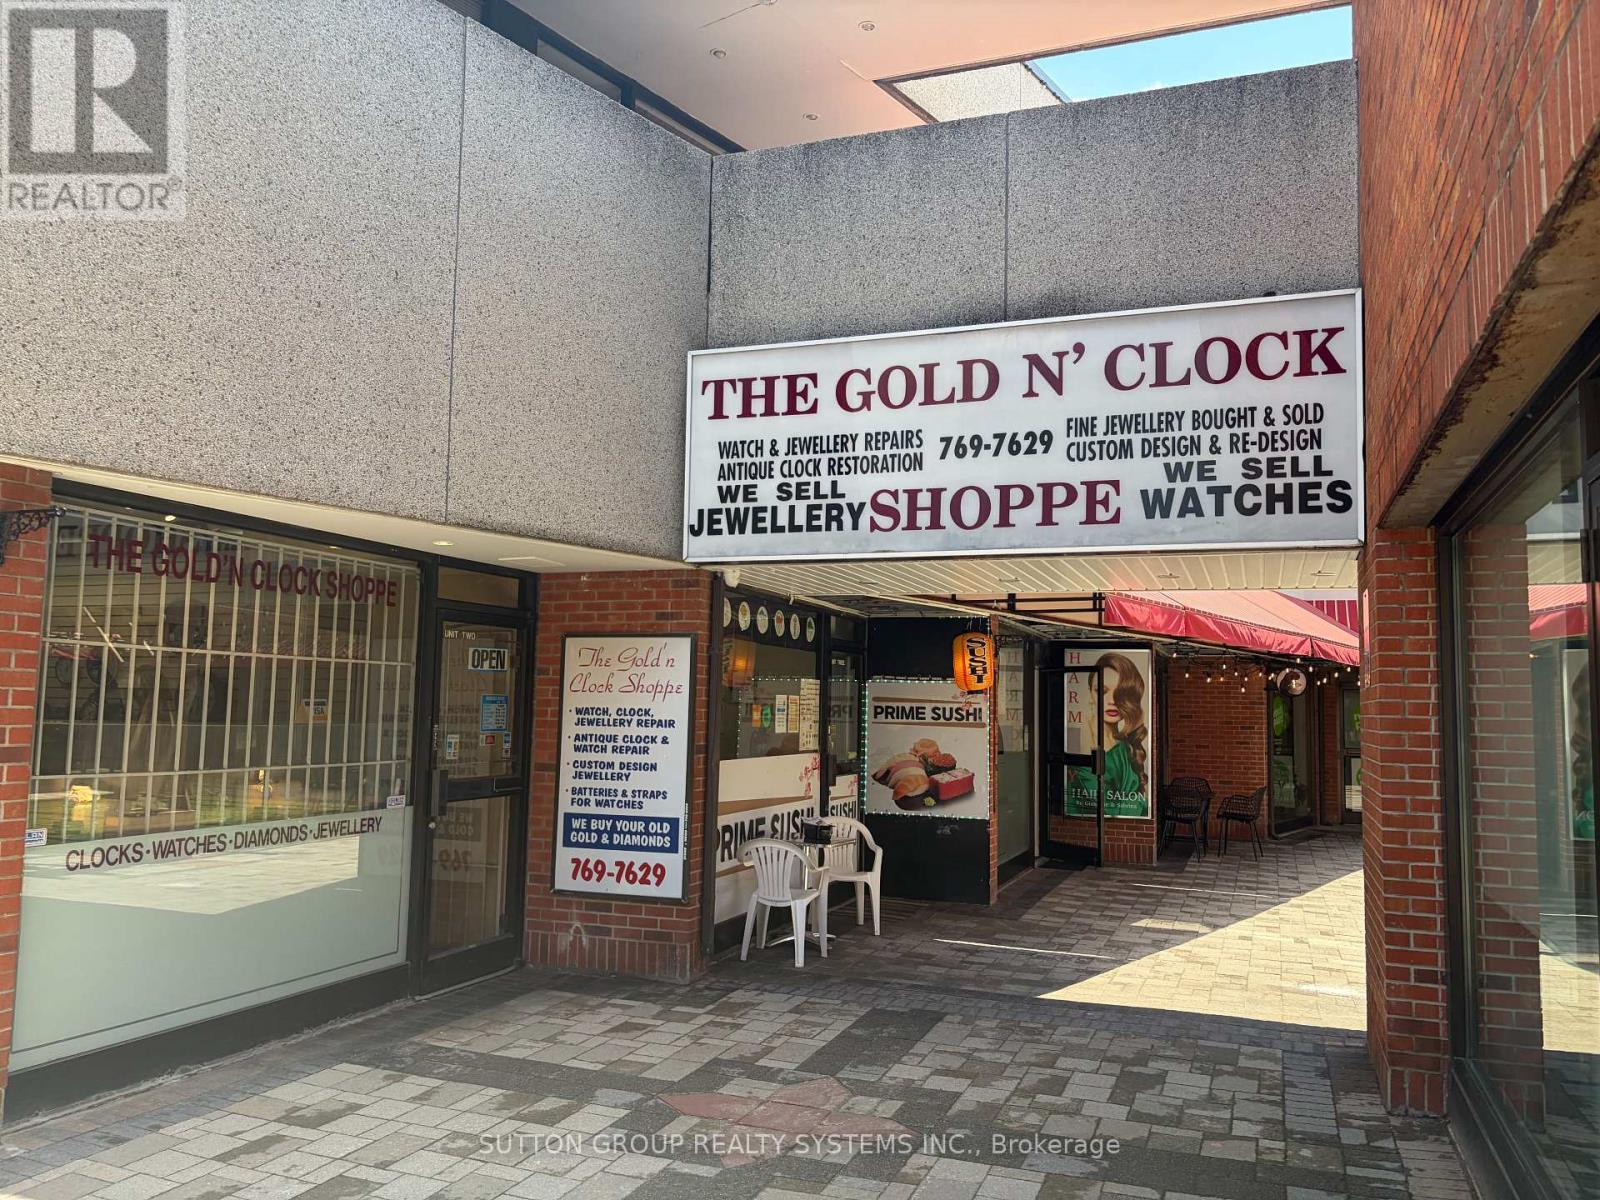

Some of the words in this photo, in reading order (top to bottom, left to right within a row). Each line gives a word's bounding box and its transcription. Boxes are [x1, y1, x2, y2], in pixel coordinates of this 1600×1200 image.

[701, 373, 818, 420] THE
[835, 358, 1000, 414] GOLD
[1022, 342, 1086, 398] N'
[1104, 327, 1347, 391] CLOCK
[1066, 416, 1097, 438] FINE
[1102, 411, 1185, 436] JEWELLERY
[1192, 407, 1257, 431] BOUGHT
[1263, 406, 1276, 426] &
[1283, 403, 1324, 426] SOLD
[718, 439, 763, 460] WATCH
[770, 439, 780, 457] &
[784, 434, 859, 456] JEWELLERY
[864, 429, 923, 451] REPAIRS
[939, 429, 1054, 460] 769-7629
[1066, 439, 1134, 462] CUSTOM
[1141, 435, 1201, 458] DESIGN
[1209, 434, 1222, 455] &
[1229, 428, 1322, 454] RE-DESIGN
[717, 461, 774, 481] ANTIQUE
[780, 457, 822, 479] CLOCK
[828, 452, 923, 476] RESTORATION
[1163, 460, 1217, 483] WE
[1241, 455, 1333, 480] SELL
[717, 484, 758, 504] WE
[776, 481, 846, 501] SELL
[1140, 479, 1353, 520] WATCHES
[869, 480, 1120, 533] SHOPPE
[689, 502, 866, 537] JEWELLERY
[88, 533, 143, 573] THE
[152, 543, 244, 587] GOLD'N
[252, 559, 321, 597] CLOCK
[326, 570, 397, 607] SHOPPE
[444, 630, 459, 638] UNIT
[462, 631, 476, 640] TWO
[472, 649, 506, 669] OPEN
[578, 647, 612, 667] The
[569, 672, 614, 693] Clock
[617, 672, 685, 702] Shoppe
[574, 717, 633, 727] JEWELLERY
[636, 718, 676, 728] REPAIR
[575, 707, 611, 717] WATCH,
[616, 707, 654, 718] CLOCK,
[872, 705, 927, 721] PRIME
[930, 705, 983, 722] SUSHI
[573, 733, 619, 743] ANTIQUE
[622, 735, 657, 744] CLOCK
[660, 735, 669, 744] &
[573, 744, 607, 754] WATCH
[611, 745, 650, 755] REPAIR
[572, 760, 614, 770] CUSTOM
[619, 761, 657, 772] DESIGN
[572, 771, 631, 781] JEWELLERY
[570, 797, 591, 807] FOR
[595, 799, 644, 810] WATCHES
[571, 787, 618, 798] BATTERIES
[621, 788, 628, 798] &
[631, 789, 668, 800] STRAPS
[1107, 790, 1146, 802] SALON
[233, 824, 309, 850] DIAMONDS
[313, 816, 383, 840] JEWELLERY
[571, 818, 587, 830] WE
[591, 819, 613, 831] BUY
[616, 820, 645, 833] YOUR
[648, 822, 671, 834] OLD
[152, 833, 227, 860] WATCHES
[570, 831, 598, 843] GOLD
[601, 833, 609, 844] &
[613, 833, 671, 848] DIAMONDS
[65, 842, 145, 872] CLOCKS
[570, 857, 667, 887] 769-7629
